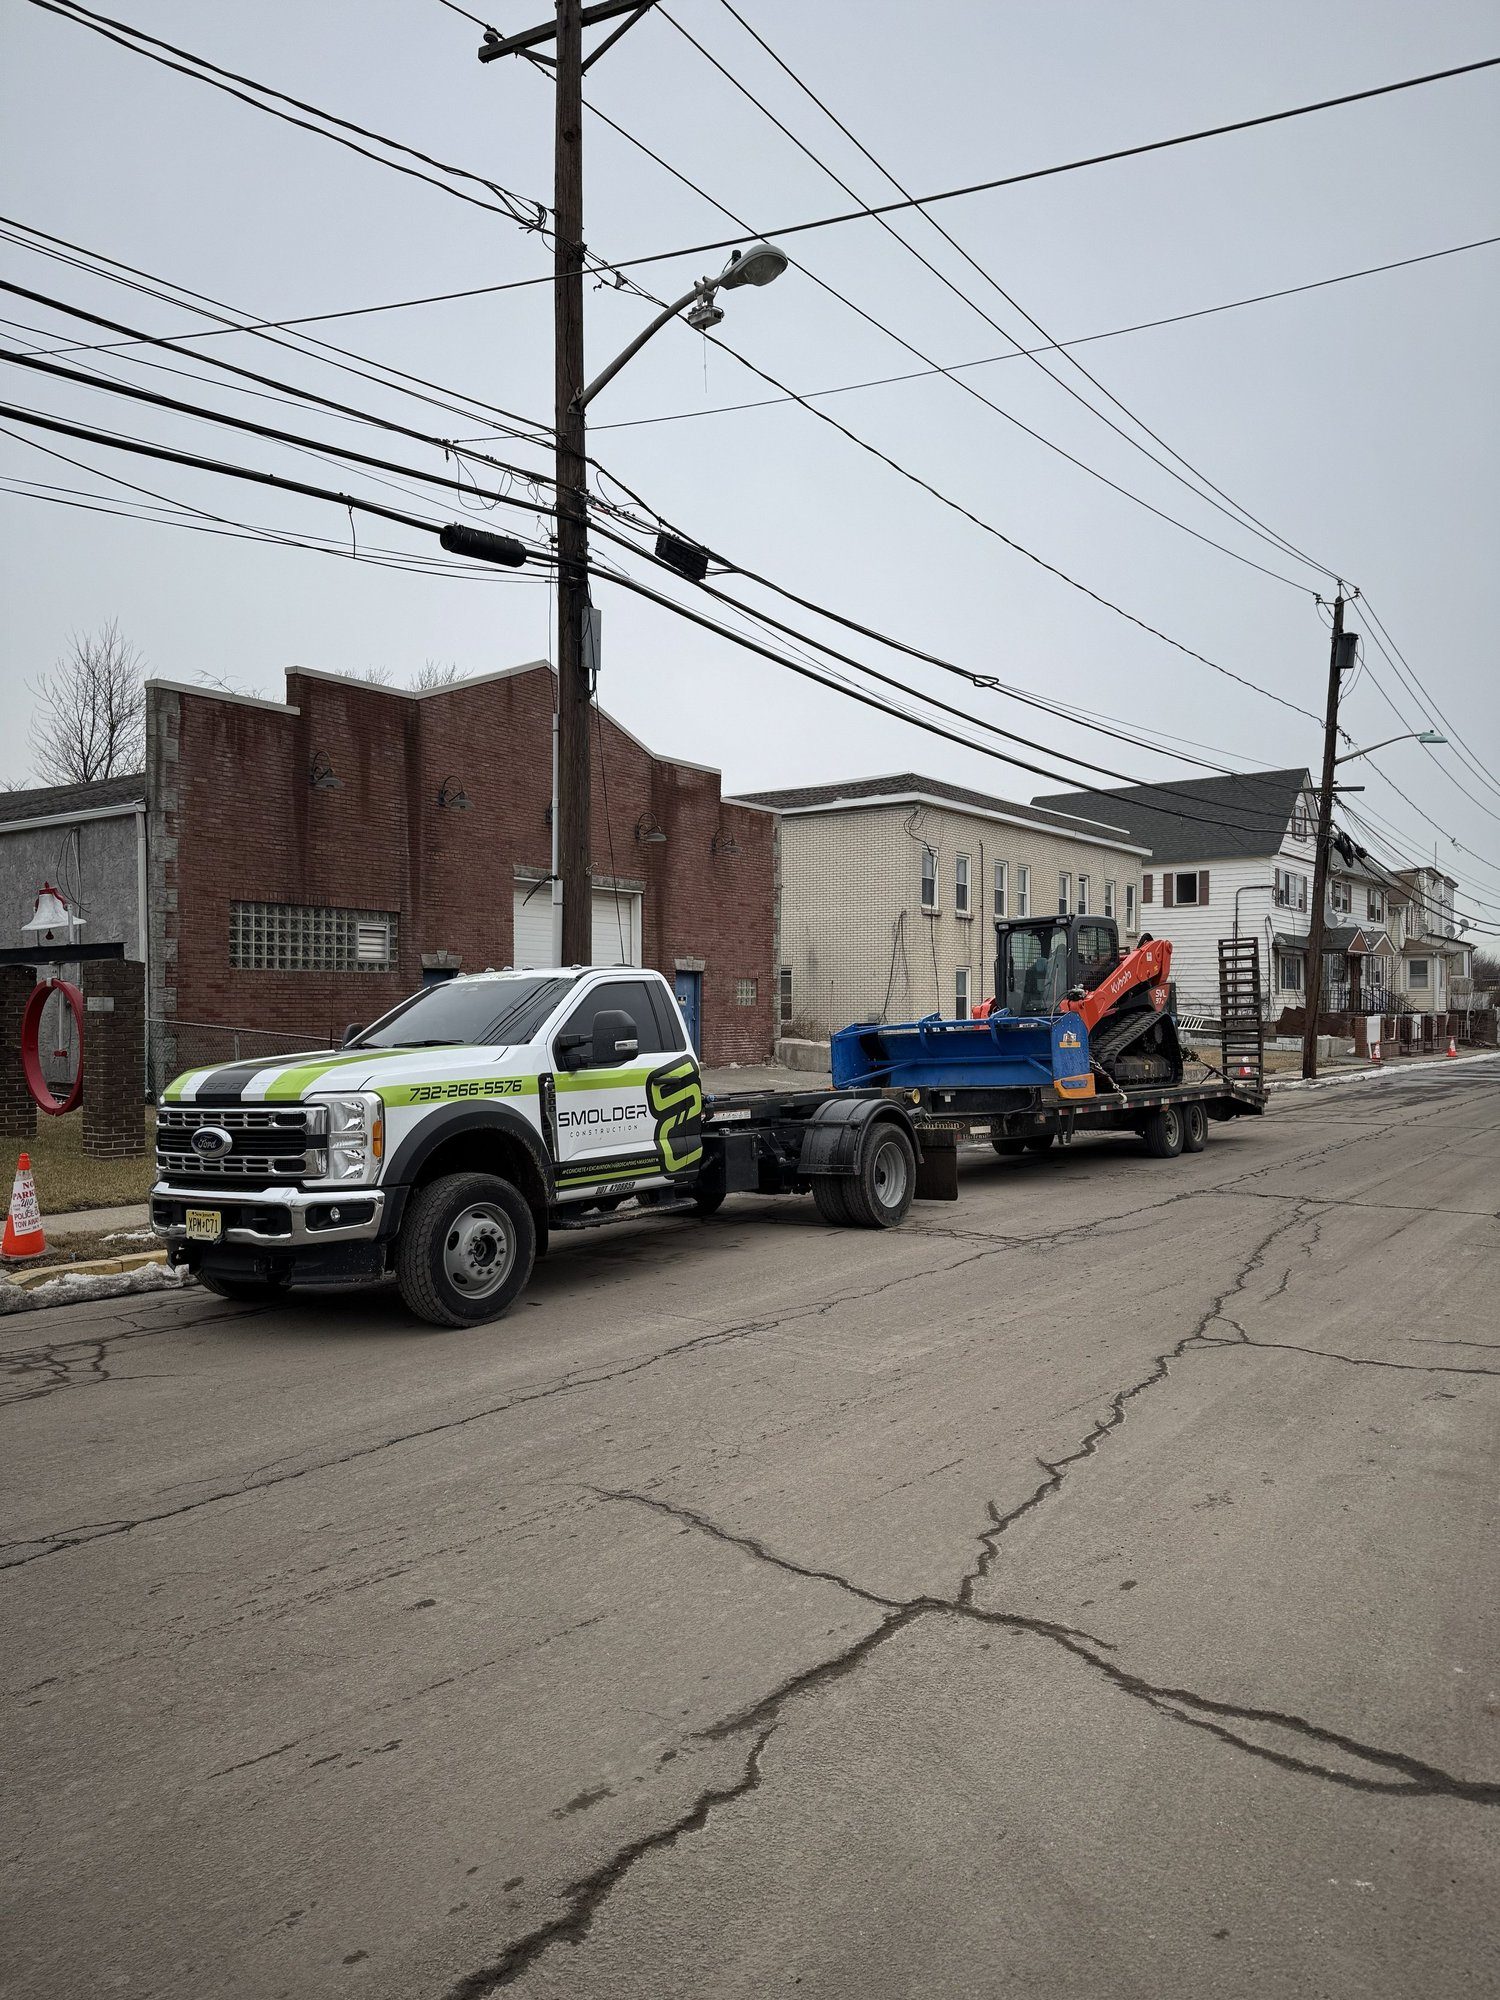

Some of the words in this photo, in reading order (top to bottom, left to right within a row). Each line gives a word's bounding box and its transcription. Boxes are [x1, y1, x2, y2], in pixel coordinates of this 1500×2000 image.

[409, 1079, 523, 1102] 732-266-5576
[558, 1104, 647, 1127] SMOLDER
[569, 1125, 639, 1138] CONSTRUCTION
[197, 1137, 216, 1149] Ford
